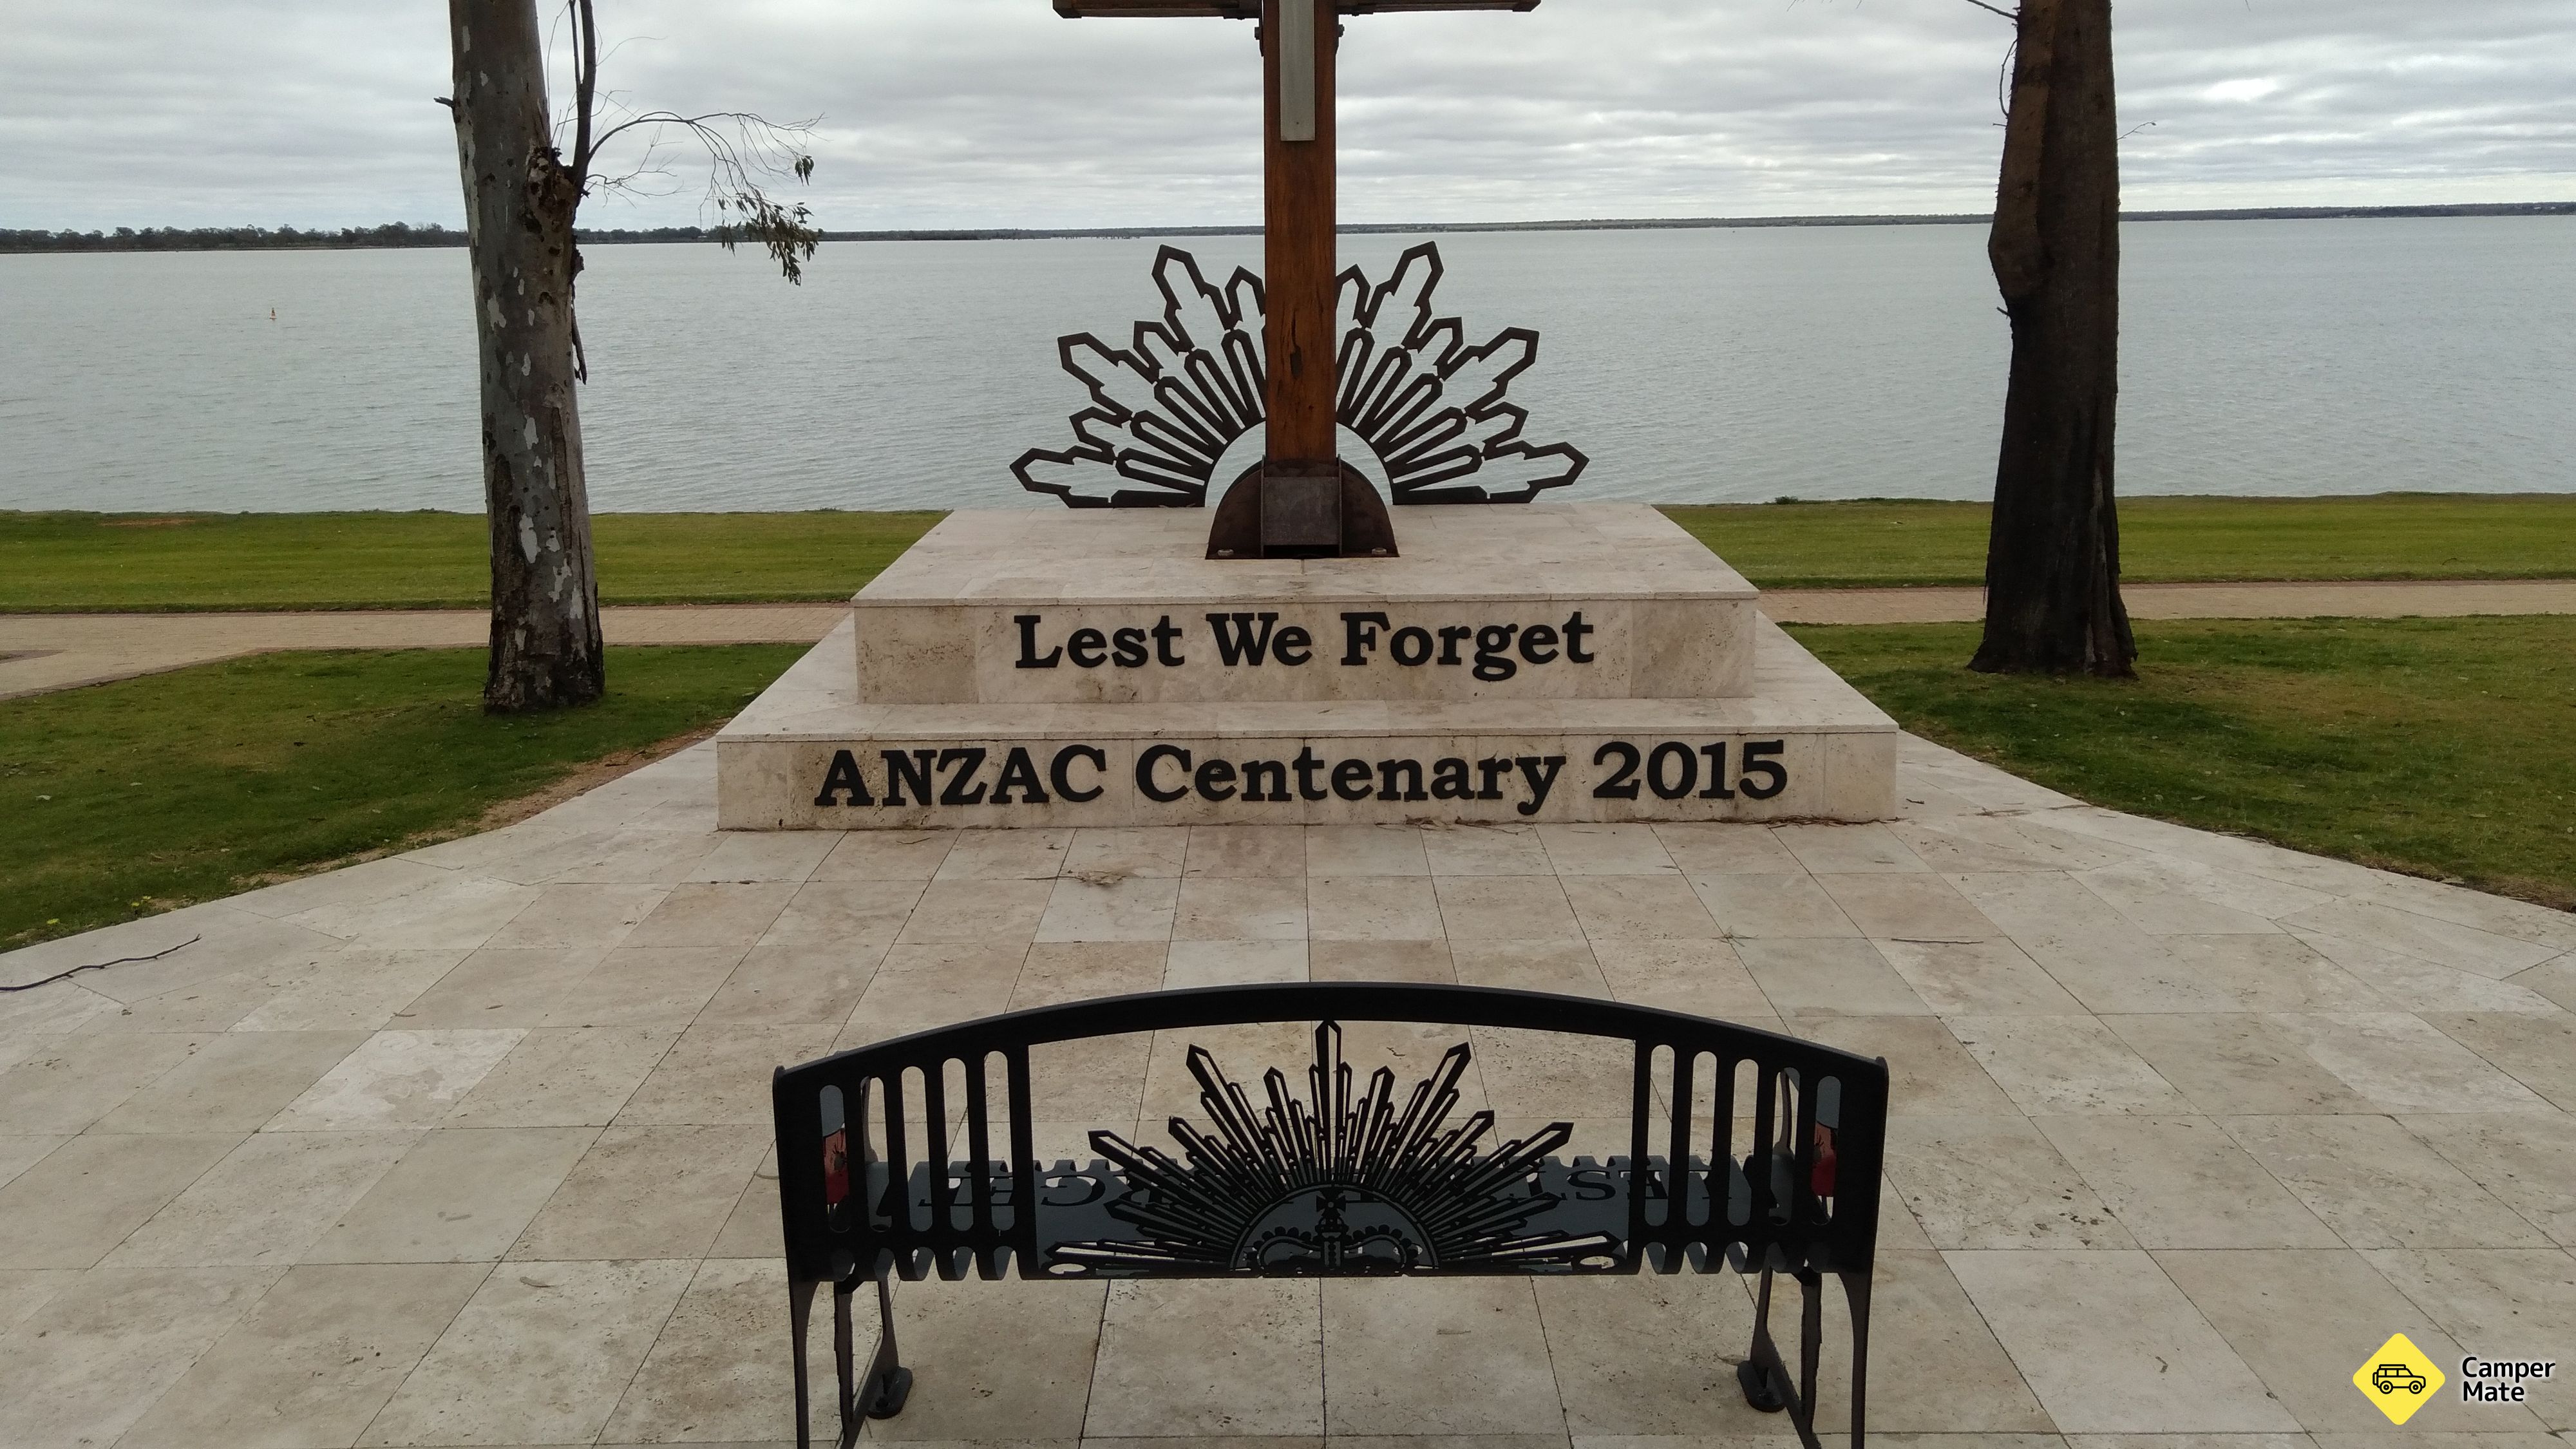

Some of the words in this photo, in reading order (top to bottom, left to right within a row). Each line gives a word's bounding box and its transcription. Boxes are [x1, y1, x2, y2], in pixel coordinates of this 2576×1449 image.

[1014, 614, 1185, 669] Lest
[1206, 612, 1312, 667] We
[1340, 611, 1595, 683] Forget
[814, 744, 1106, 808] ANZAC
[1135, 743, 1567, 816] Centenary
[1593, 739, 1788, 801] 2015
